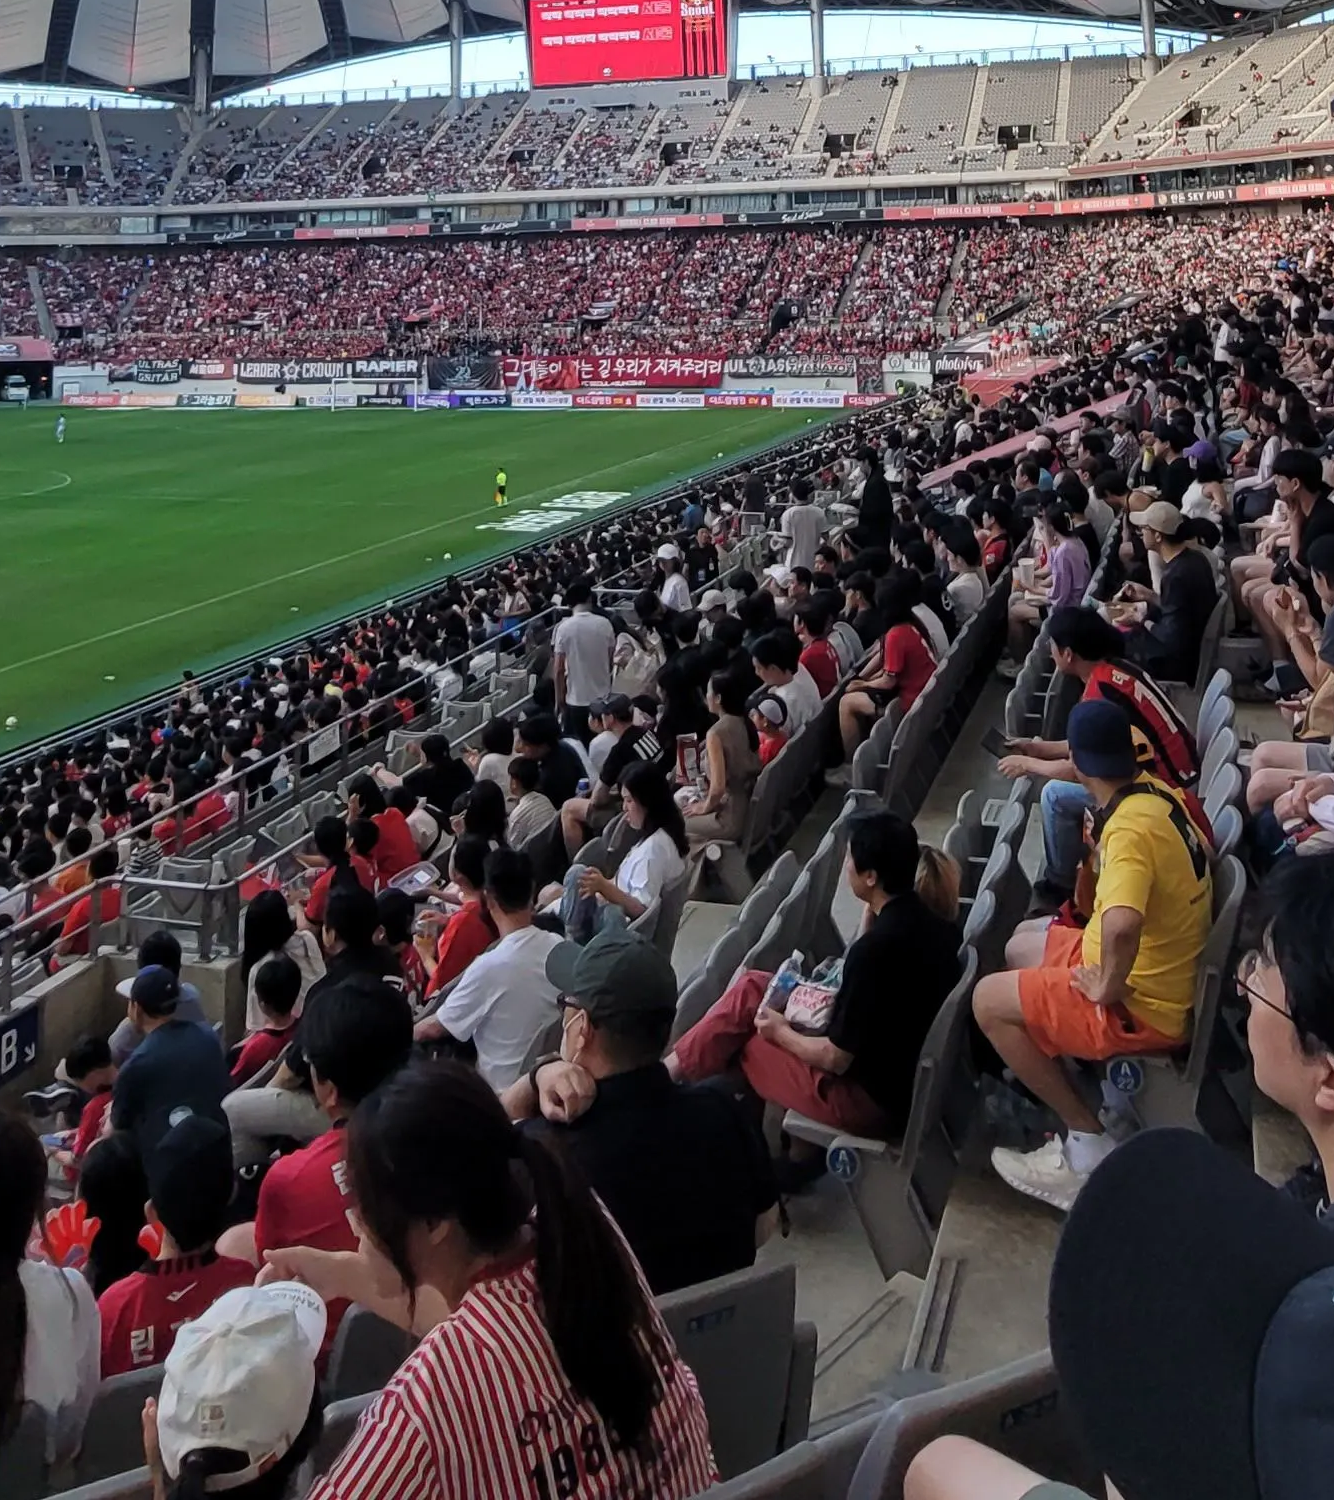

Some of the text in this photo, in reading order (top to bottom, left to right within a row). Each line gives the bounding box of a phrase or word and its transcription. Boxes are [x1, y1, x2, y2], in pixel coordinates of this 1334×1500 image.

[1187, 192, 1204, 202] SKY
[1207, 190, 1225, 200] PUB
[1228, 189, 1234, 199] 1
[138, 360, 180, 369] ULTRAS
[240, 361, 344, 378] LEADER CROWN
[355, 360, 418, 373] RAPIER
[598, 359, 611, 379] 길
[612, 358, 652, 378] 우리가
[1121, 1061, 1132, 1076] A
